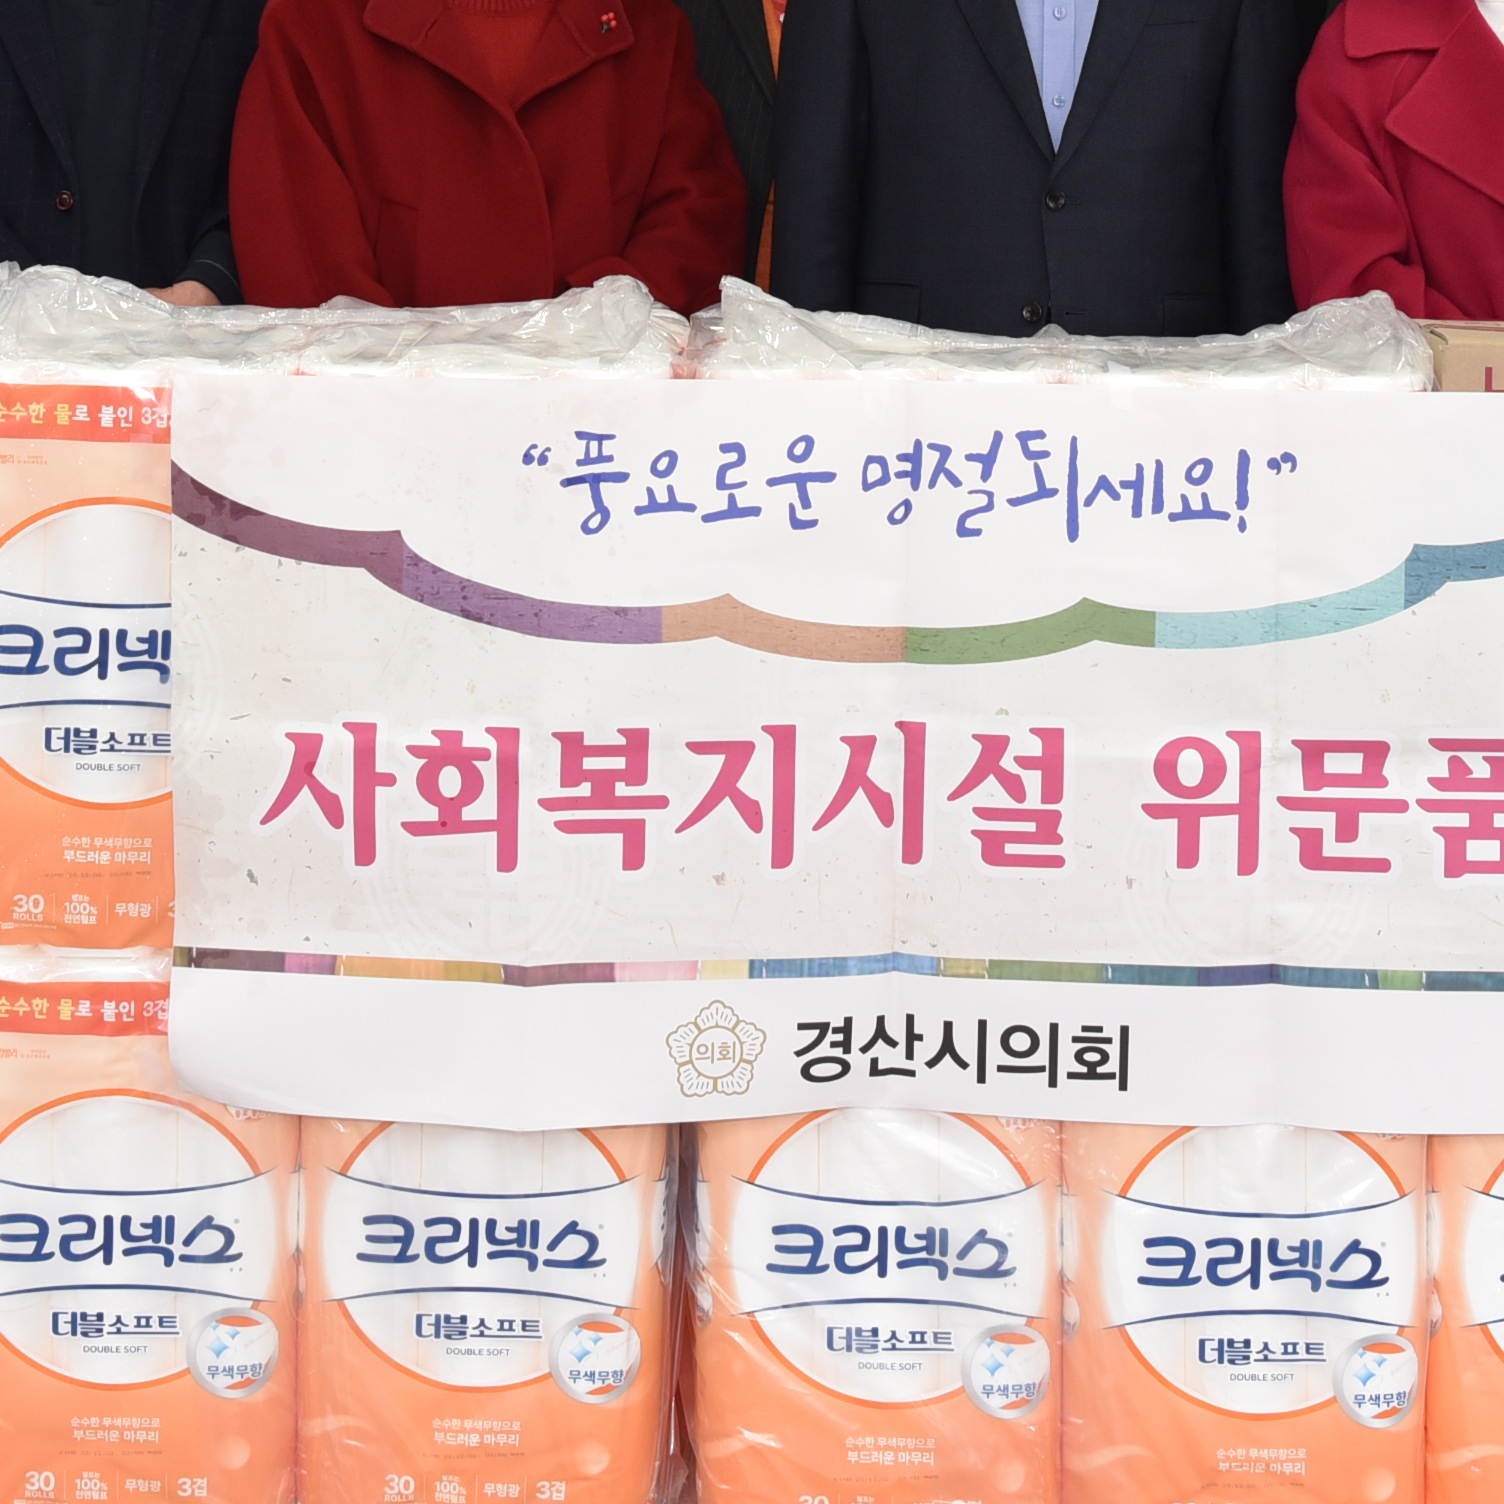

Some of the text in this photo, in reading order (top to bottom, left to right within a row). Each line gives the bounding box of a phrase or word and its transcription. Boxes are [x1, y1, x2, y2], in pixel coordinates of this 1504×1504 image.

[76, 762, 141, 773] DOUBLE SOFT
[257, 718, 1069, 875] 사회복지시설
[62, 836, 153, 848] 순수한 무색무향으로
[13, 894, 45, 913] 30
[64, 902, 98, 914] 100%
[115, 902, 152, 918] 무형광
[13, 913, 43, 921] ROLLS
[694, 1013, 1131, 1091] 의회 경산시의회
[356, 1214, 607, 1273] 크리넥스
[765, 1224, 1017, 1282] 크리넥스
[1137, 1236, 1390, 1293] 크리넥스
[51, 1311, 181, 1338] 더블소프트
[415, 1313, 543, 1342] 더블소프트
[826, 1325, 955, 1354] 더블소프트
[82, 1345, 148, 1354] DOUBLE SOFT
[446, 1347, 510, 1357] DOUBLE SOFT
[1199, 1337, 1327, 1366] 더블소프트
[858, 1362, 923, 1371] DOUBLE SOFT
[1230, 1373, 1295, 1382] DOUBLE SOFT
